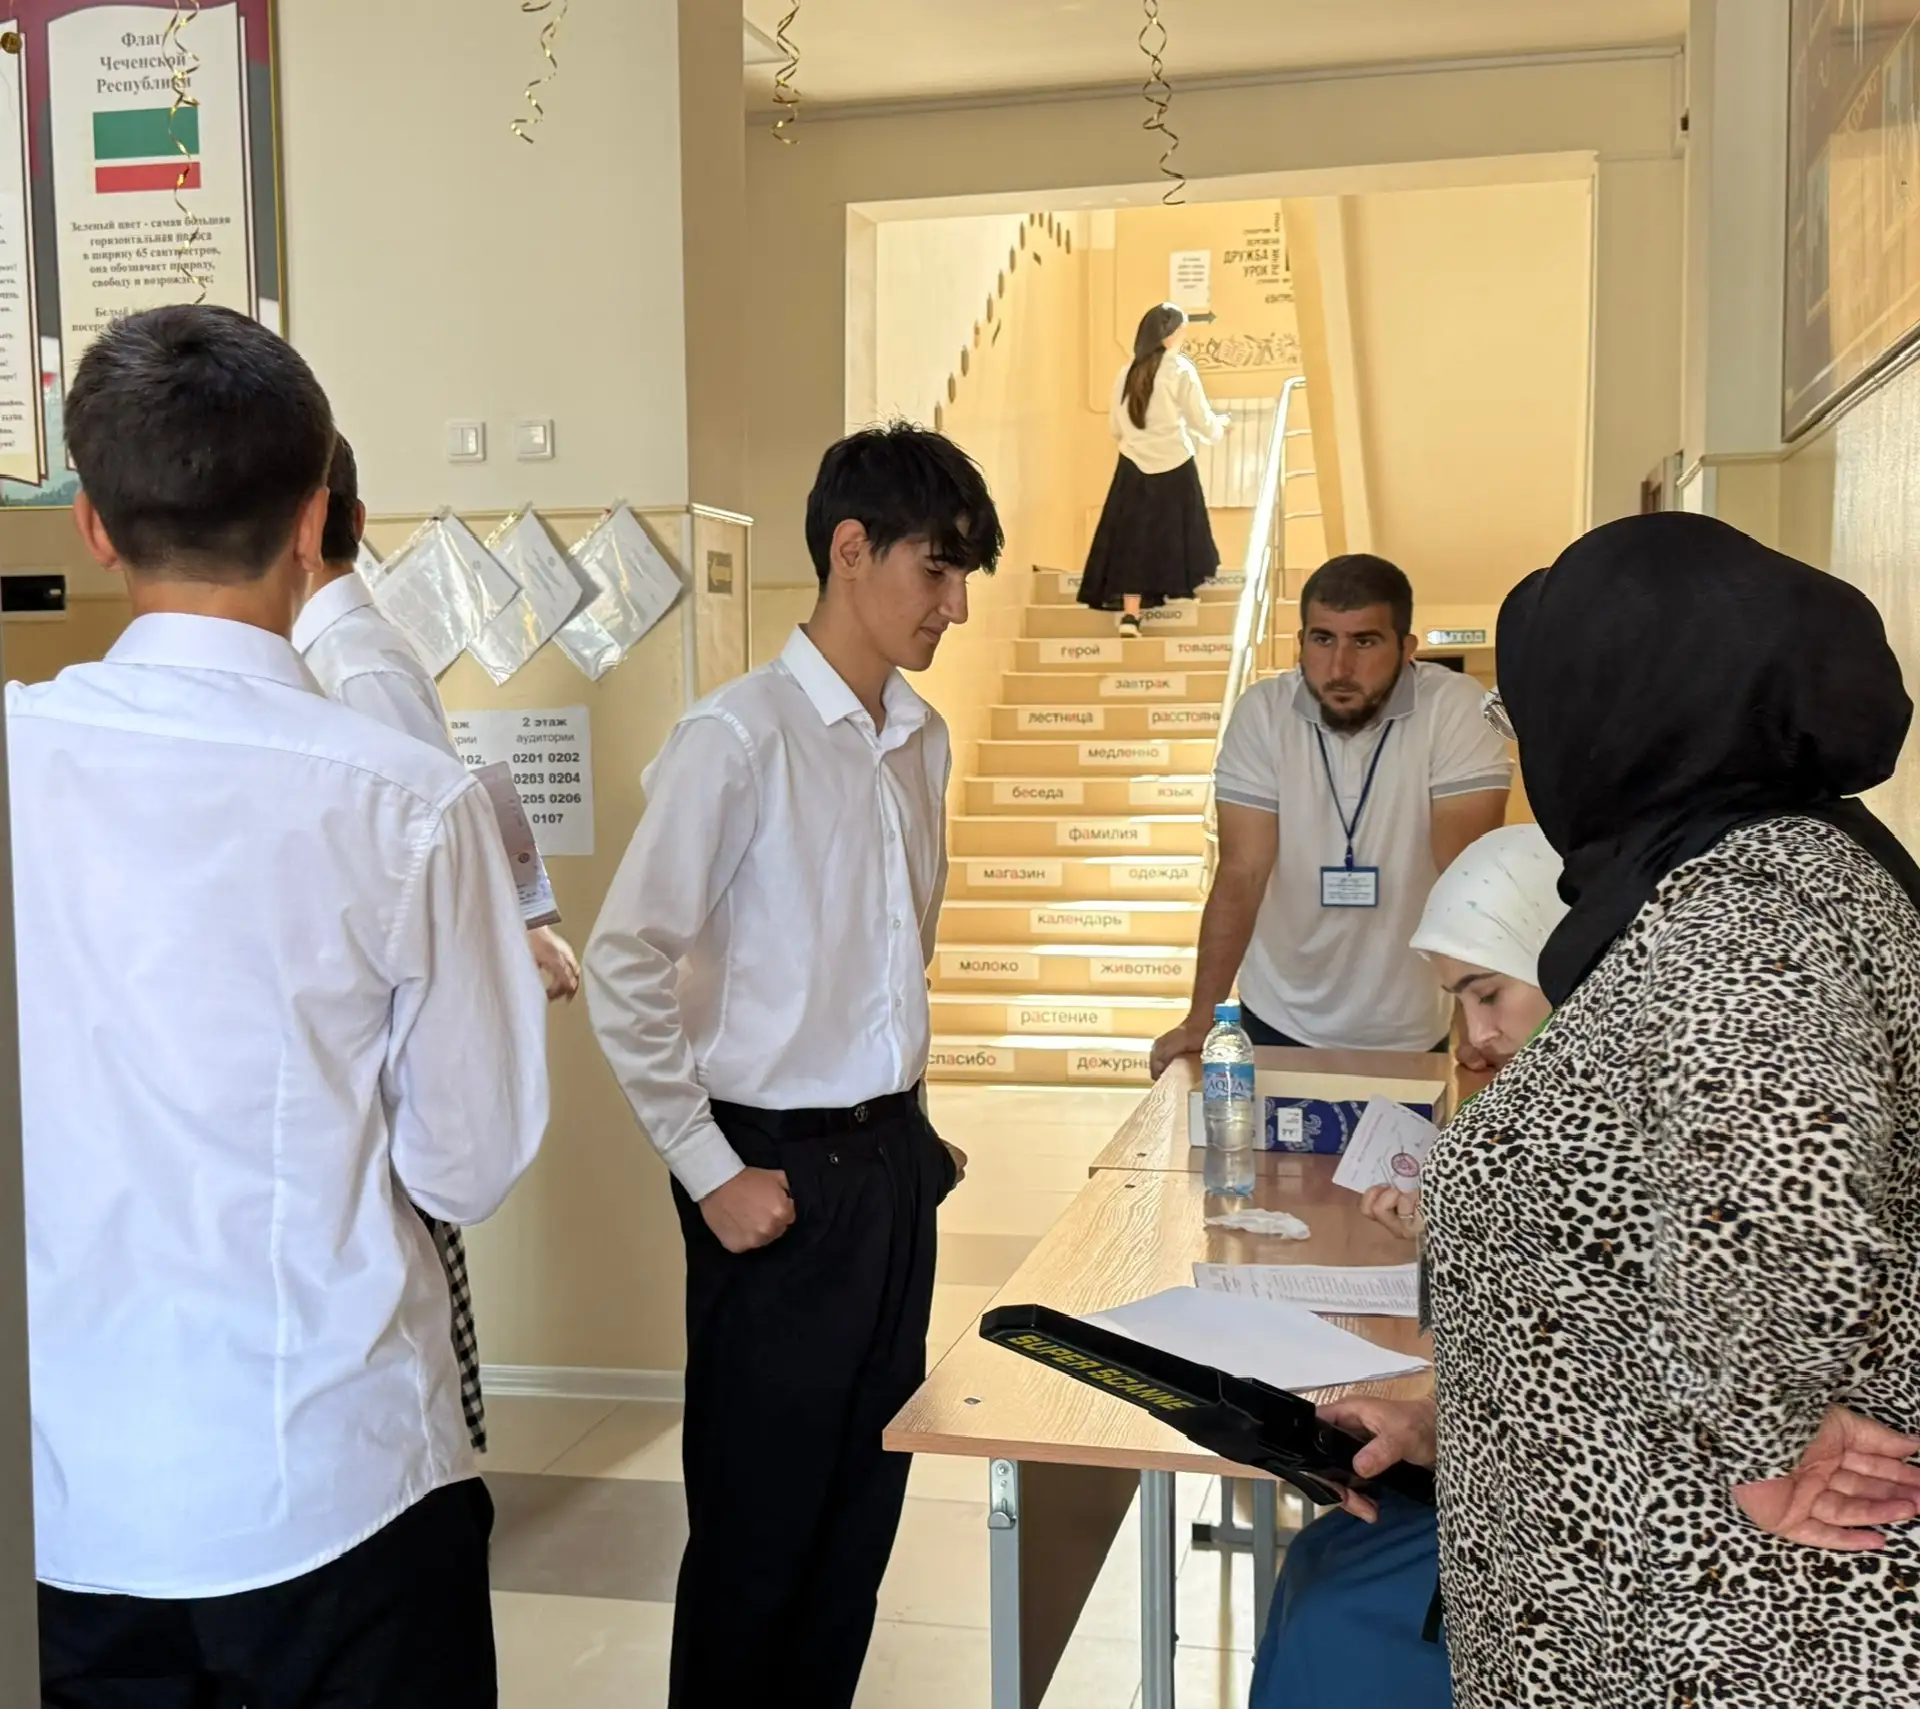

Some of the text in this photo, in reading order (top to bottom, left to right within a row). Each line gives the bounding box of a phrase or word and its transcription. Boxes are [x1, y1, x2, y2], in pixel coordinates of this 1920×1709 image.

[121, 33, 163, 48] Флаг
[100, 51, 186, 72] Чеченской
[97, 75, 192, 95] Республики
[71, 220, 116, 233] Зеленый
[118, 220, 142, 230] цвет
[151, 217, 182, 228] самая
[185, 215, 231, 226] большая
[90, 231, 213, 248] горизонтальная пооса
[83, 252, 90, 261] в
[92, 249, 133, 262] ширину
[136, 248, 149, 258] 65
[90, 260, 216, 274] она обозначает природу,
[1243, 265, 1268, 278] УРОК
[92, 275, 214, 289] свободу и возрождеие;
[1141, 610, 1182, 621] рошо
[1429, 631, 1482, 643] ЫХОД
[1061, 644, 1100, 659] герой
[1115, 679, 1169, 692] завтрак
[522, 717, 567, 727] 2 этаж
[1028, 710, 1093, 725] лестница
[516, 734, 575, 743] аудитории
[461, 754, 486, 765] 02,
[512, 752, 580, 763] 0201 0202
[1088, 746, 1159, 760] медленно
[513, 772, 581, 784] 0203 0204
[521, 793, 582, 804] 205 0206
[1012, 785, 1064, 801] беседа
[1157, 787, 1194, 799] язык
[532, 814, 564, 824] 0107
[1069, 825, 1138, 840] фамилия
[983, 867, 1045, 880] магазин
[1129, 867, 1189, 880] одежда
[1037, 912, 1122, 928] календарь
[959, 958, 1019, 973] молоко
[1101, 962, 1182, 976] животное
[1020, 1012, 1098, 1026] растение
[928, 1052, 996, 1066] спасибо
[1077, 1056, 1150, 1072] дежурн
[1007, 1334, 1096, 1370] SUPER
